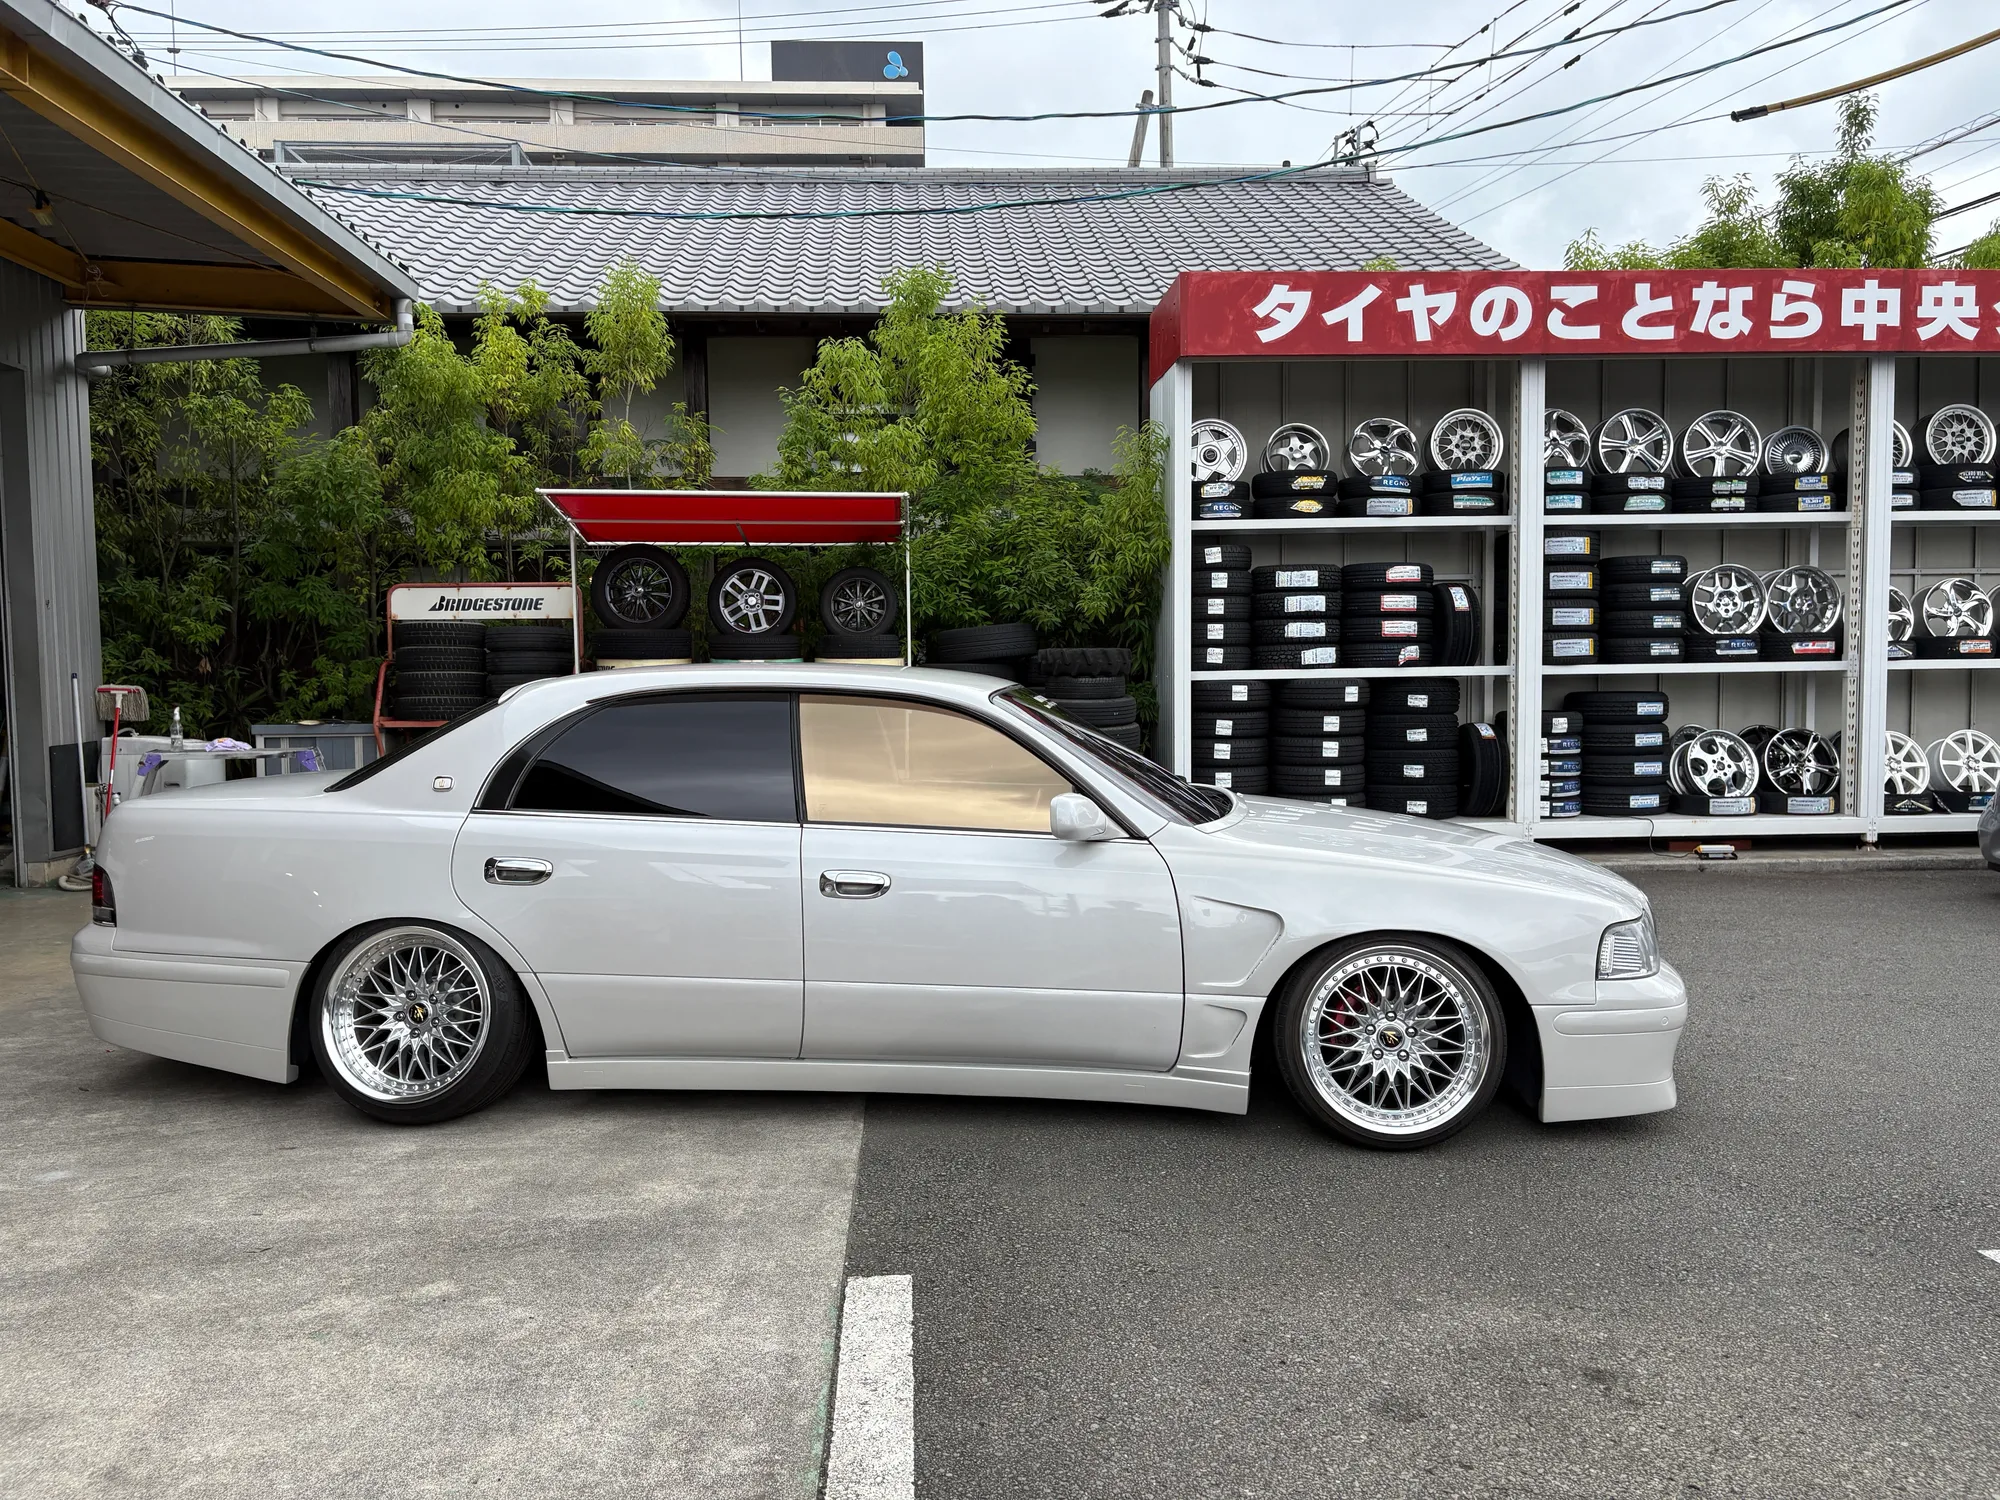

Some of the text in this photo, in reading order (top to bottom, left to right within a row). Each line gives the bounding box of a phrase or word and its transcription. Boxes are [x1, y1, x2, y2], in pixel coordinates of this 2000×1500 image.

[1252, 279, 2000, 344] タイヤのことなら中央
[1382, 479, 1410, 487] REGNO
[428, 595, 545, 612] BRIDGESTONE
